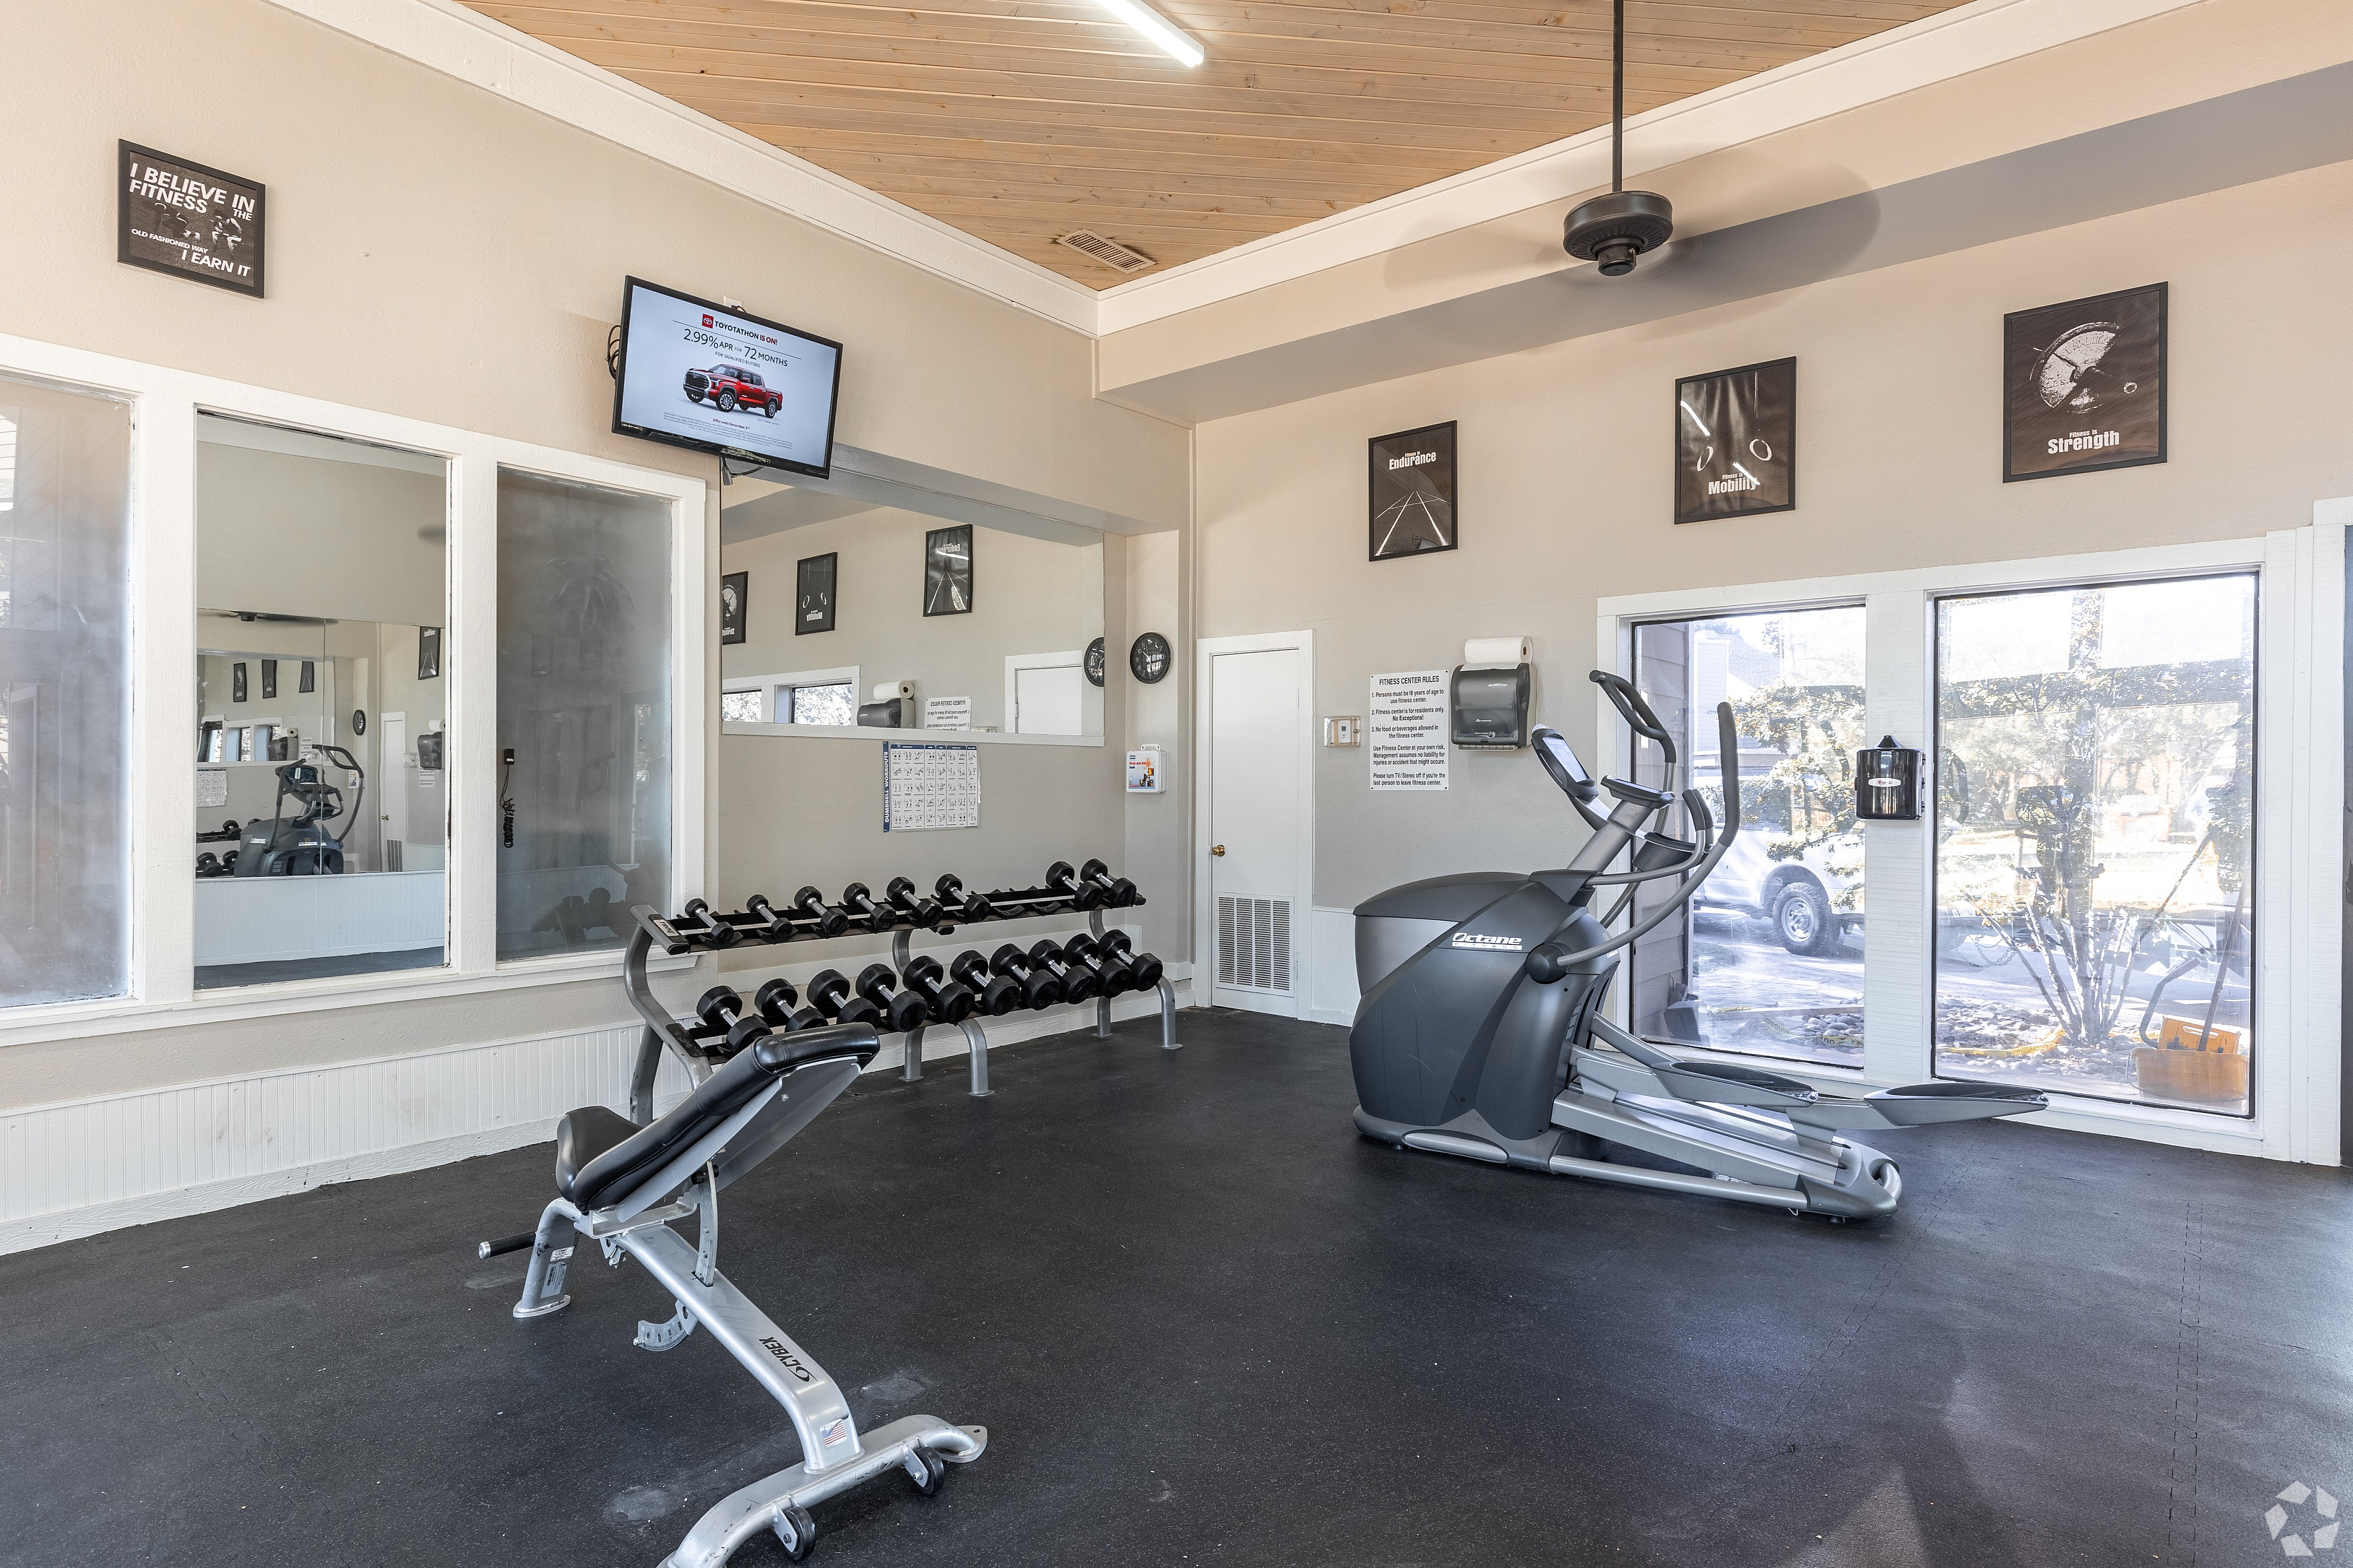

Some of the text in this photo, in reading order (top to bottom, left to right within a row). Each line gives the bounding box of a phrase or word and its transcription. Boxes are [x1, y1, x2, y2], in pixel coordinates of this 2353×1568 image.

[129, 179, 252, 221] FITNESS THE
[130, 163, 255, 213] I BELIEVE IN
[132, 229, 209, 254] OLD FASHIONED WAY
[182, 249, 252, 277] I EARN IT
[715, 320, 759, 339] TOYOTATHON
[766, 337, 778, 345] ON!
[684, 329, 719, 349] 2.99%
[719, 341, 733, 351] APR
[744, 346, 757, 360] 72
[758, 352, 788, 367] MONTHS
[724, 354, 745, 364] QUALIFIED
[746, 360, 761, 368] BUYERS
[2047, 431, 2120, 454] Strength
[1389, 451, 1437, 470] Endurance
[1708, 477, 1758, 495] Mobility
[1379, 678, 1400, 686] FITNESS
[1401, 677, 1421, 685] CENTER
[1452, 932, 1522, 945] Octane
[758, 1337, 802, 1368] CYBEX
